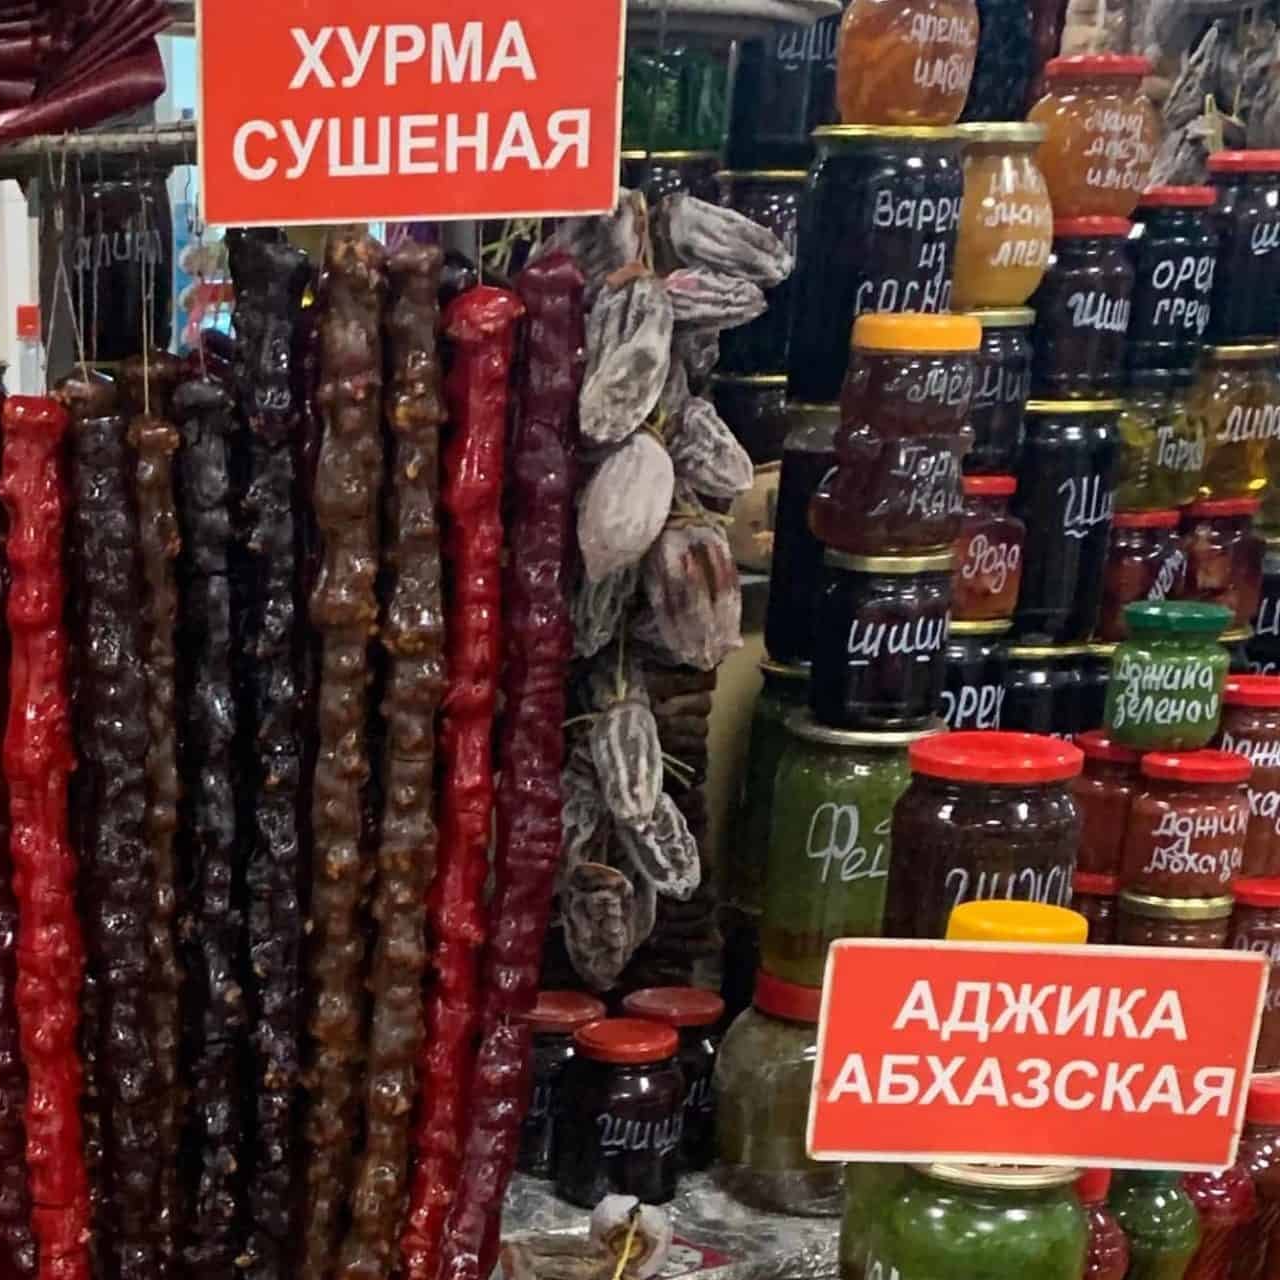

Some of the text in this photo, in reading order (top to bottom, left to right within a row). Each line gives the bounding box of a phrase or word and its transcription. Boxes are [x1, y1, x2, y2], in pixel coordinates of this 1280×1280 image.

[288, 20, 538, 90] ХУРМА
[233, 108, 591, 181] СУШЕНАЯ
[962, 534, 1020, 593] Роза
[893, 979, 1188, 1042] АДЖИКА
[827, 1053, 1236, 1117] АБХАЗСКАЯ
